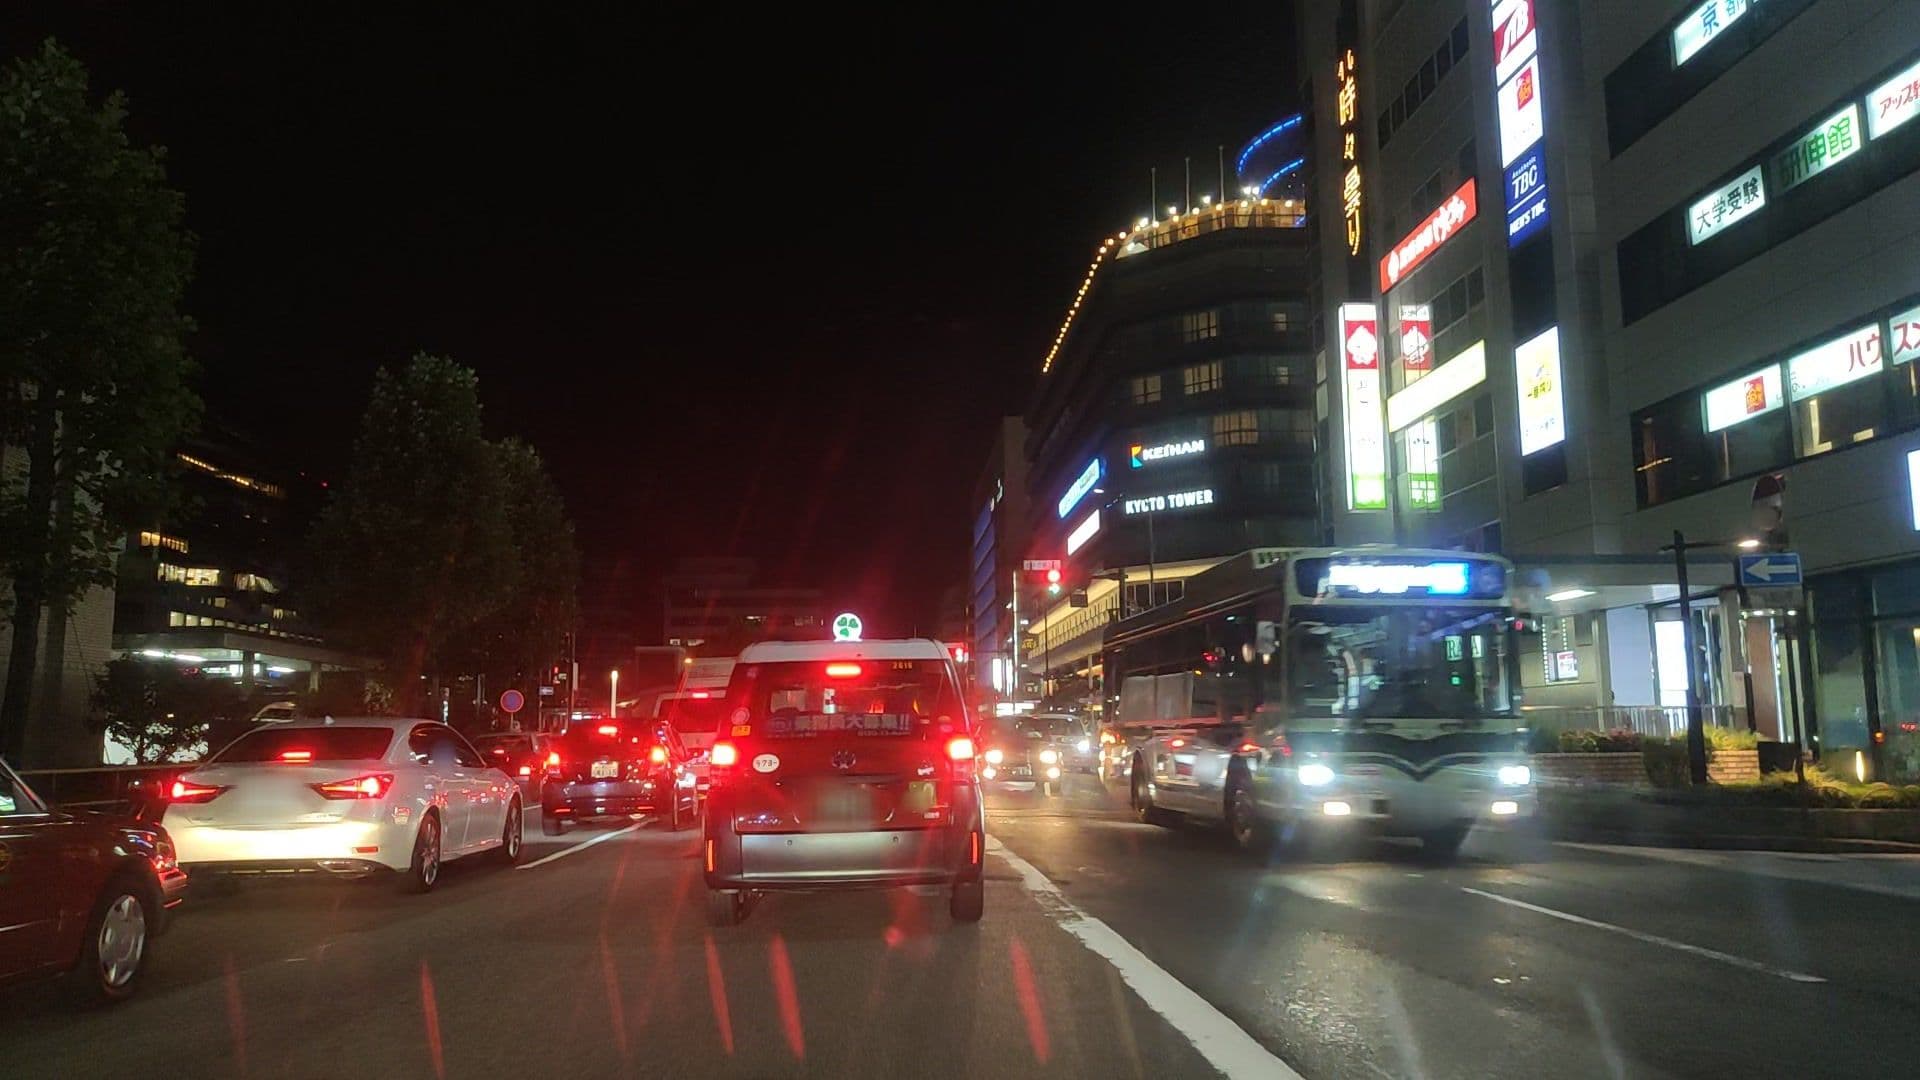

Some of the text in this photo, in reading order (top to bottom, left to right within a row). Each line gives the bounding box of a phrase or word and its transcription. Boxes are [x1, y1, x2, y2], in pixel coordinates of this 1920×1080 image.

[1511, 164, 1538, 200] TBC
[1696, 176, 1761, 235] 大学受験
[1142, 439, 1206, 461] KEIHAN
[1125, 488, 1214, 515] KYOTO TOWER
